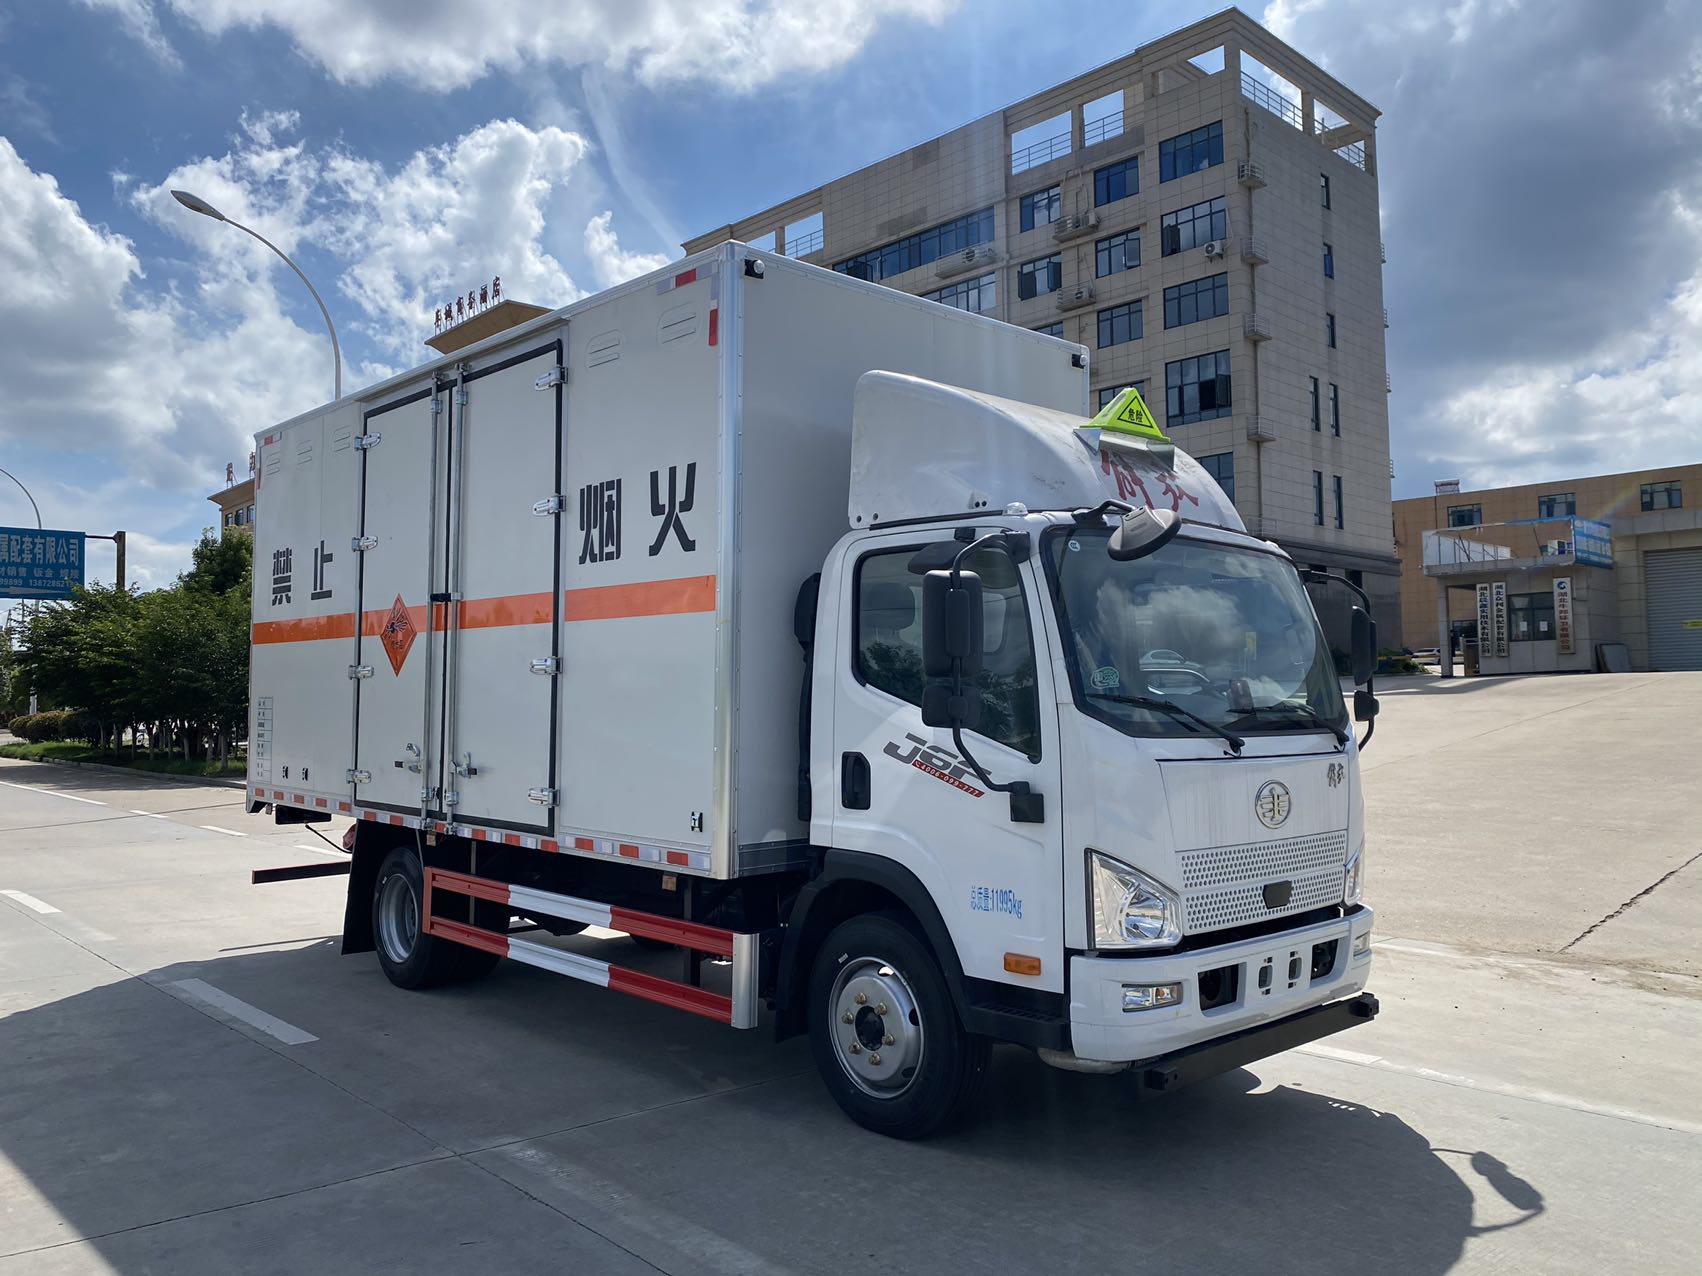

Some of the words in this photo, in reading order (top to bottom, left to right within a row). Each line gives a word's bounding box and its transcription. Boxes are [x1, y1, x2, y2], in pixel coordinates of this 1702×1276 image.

[1128, 408, 1143, 423] 危险
[271, 540, 334, 607] 禁止
[578, 462, 697, 566] 烟火
[920, 764, 980, 797] 4006-099-777
